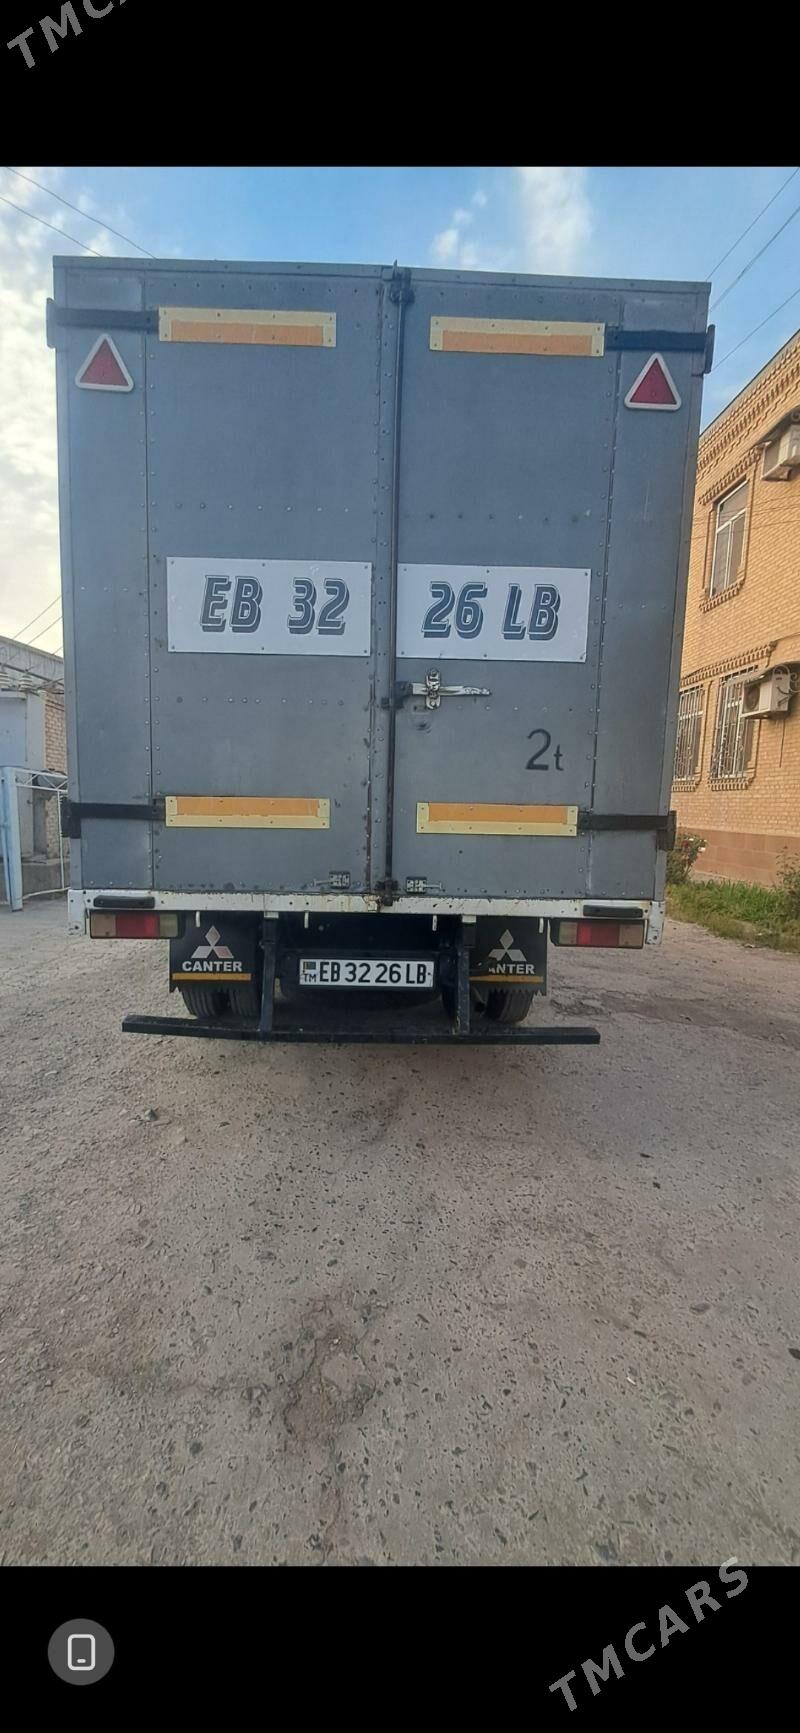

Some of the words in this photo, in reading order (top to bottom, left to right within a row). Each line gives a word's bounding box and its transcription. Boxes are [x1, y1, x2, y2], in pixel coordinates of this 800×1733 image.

[200, 574, 263, 634] EB
[287, 576, 350, 636] 32
[421, 580, 488, 639] 26
[502, 583, 561, 641] LB
[524, 728, 565, 772] 2t
[181, 960, 243, 972] CANTER
[303, 973, 317, 983] TM
[319, 961, 341, 983] EB
[344, 962, 371, 983] 32
[374, 963, 402, 984] 26
[405, 963, 427, 984] LB
